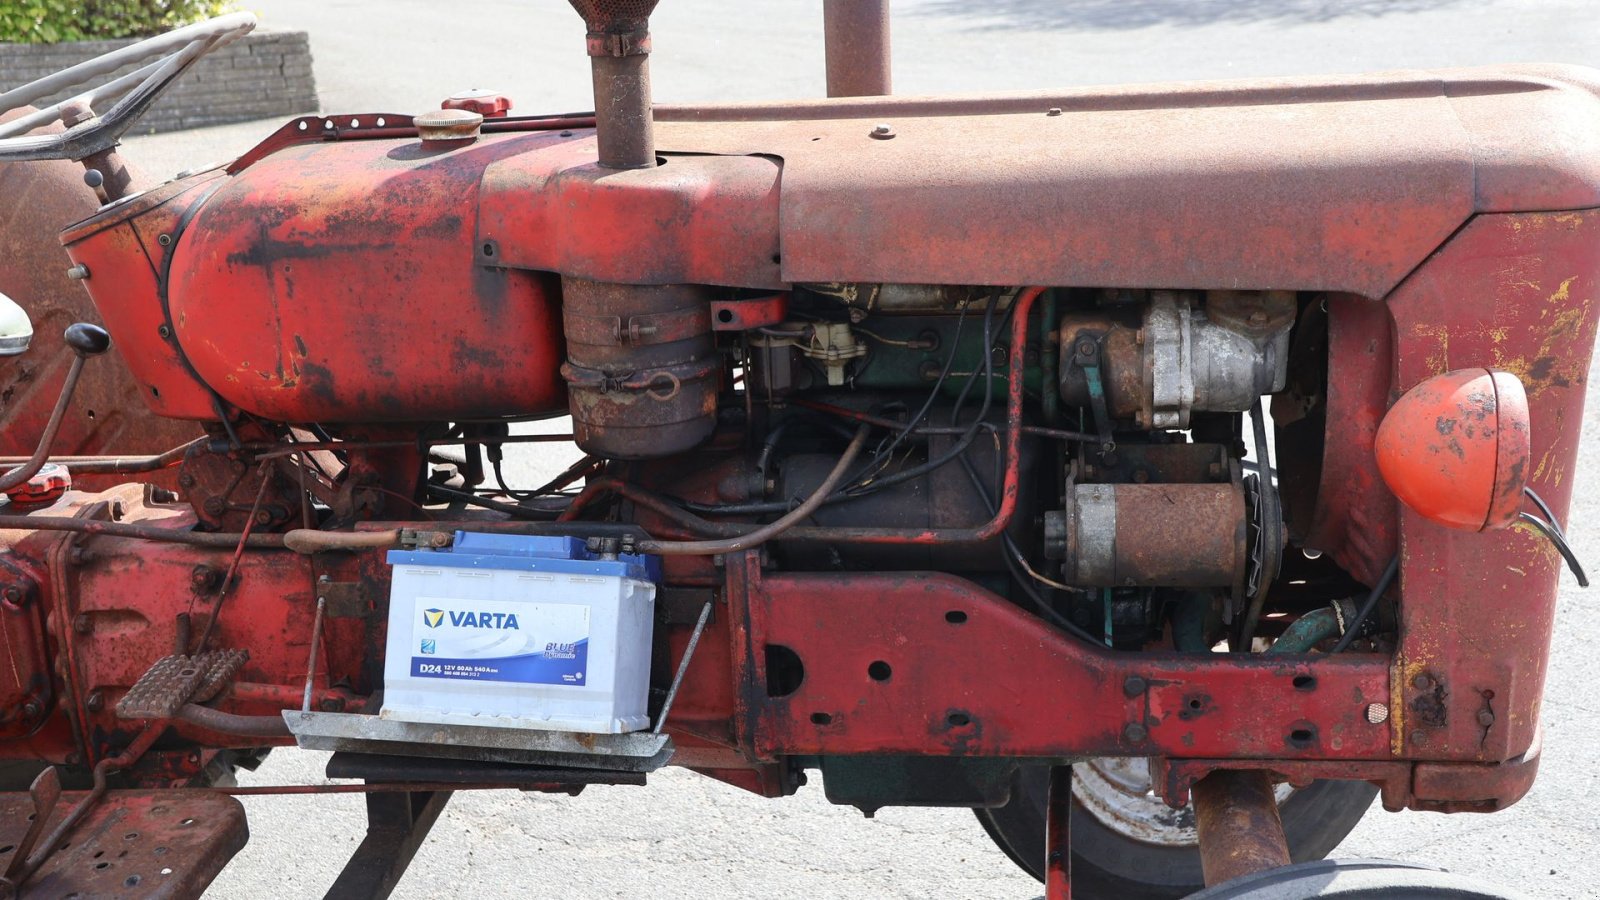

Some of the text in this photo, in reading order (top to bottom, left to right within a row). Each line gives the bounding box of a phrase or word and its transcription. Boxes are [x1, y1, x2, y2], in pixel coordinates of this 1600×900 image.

[449, 611, 520, 630] VARTA
[545, 642, 575, 652] BLUE
[419, 663, 442, 674] D24
